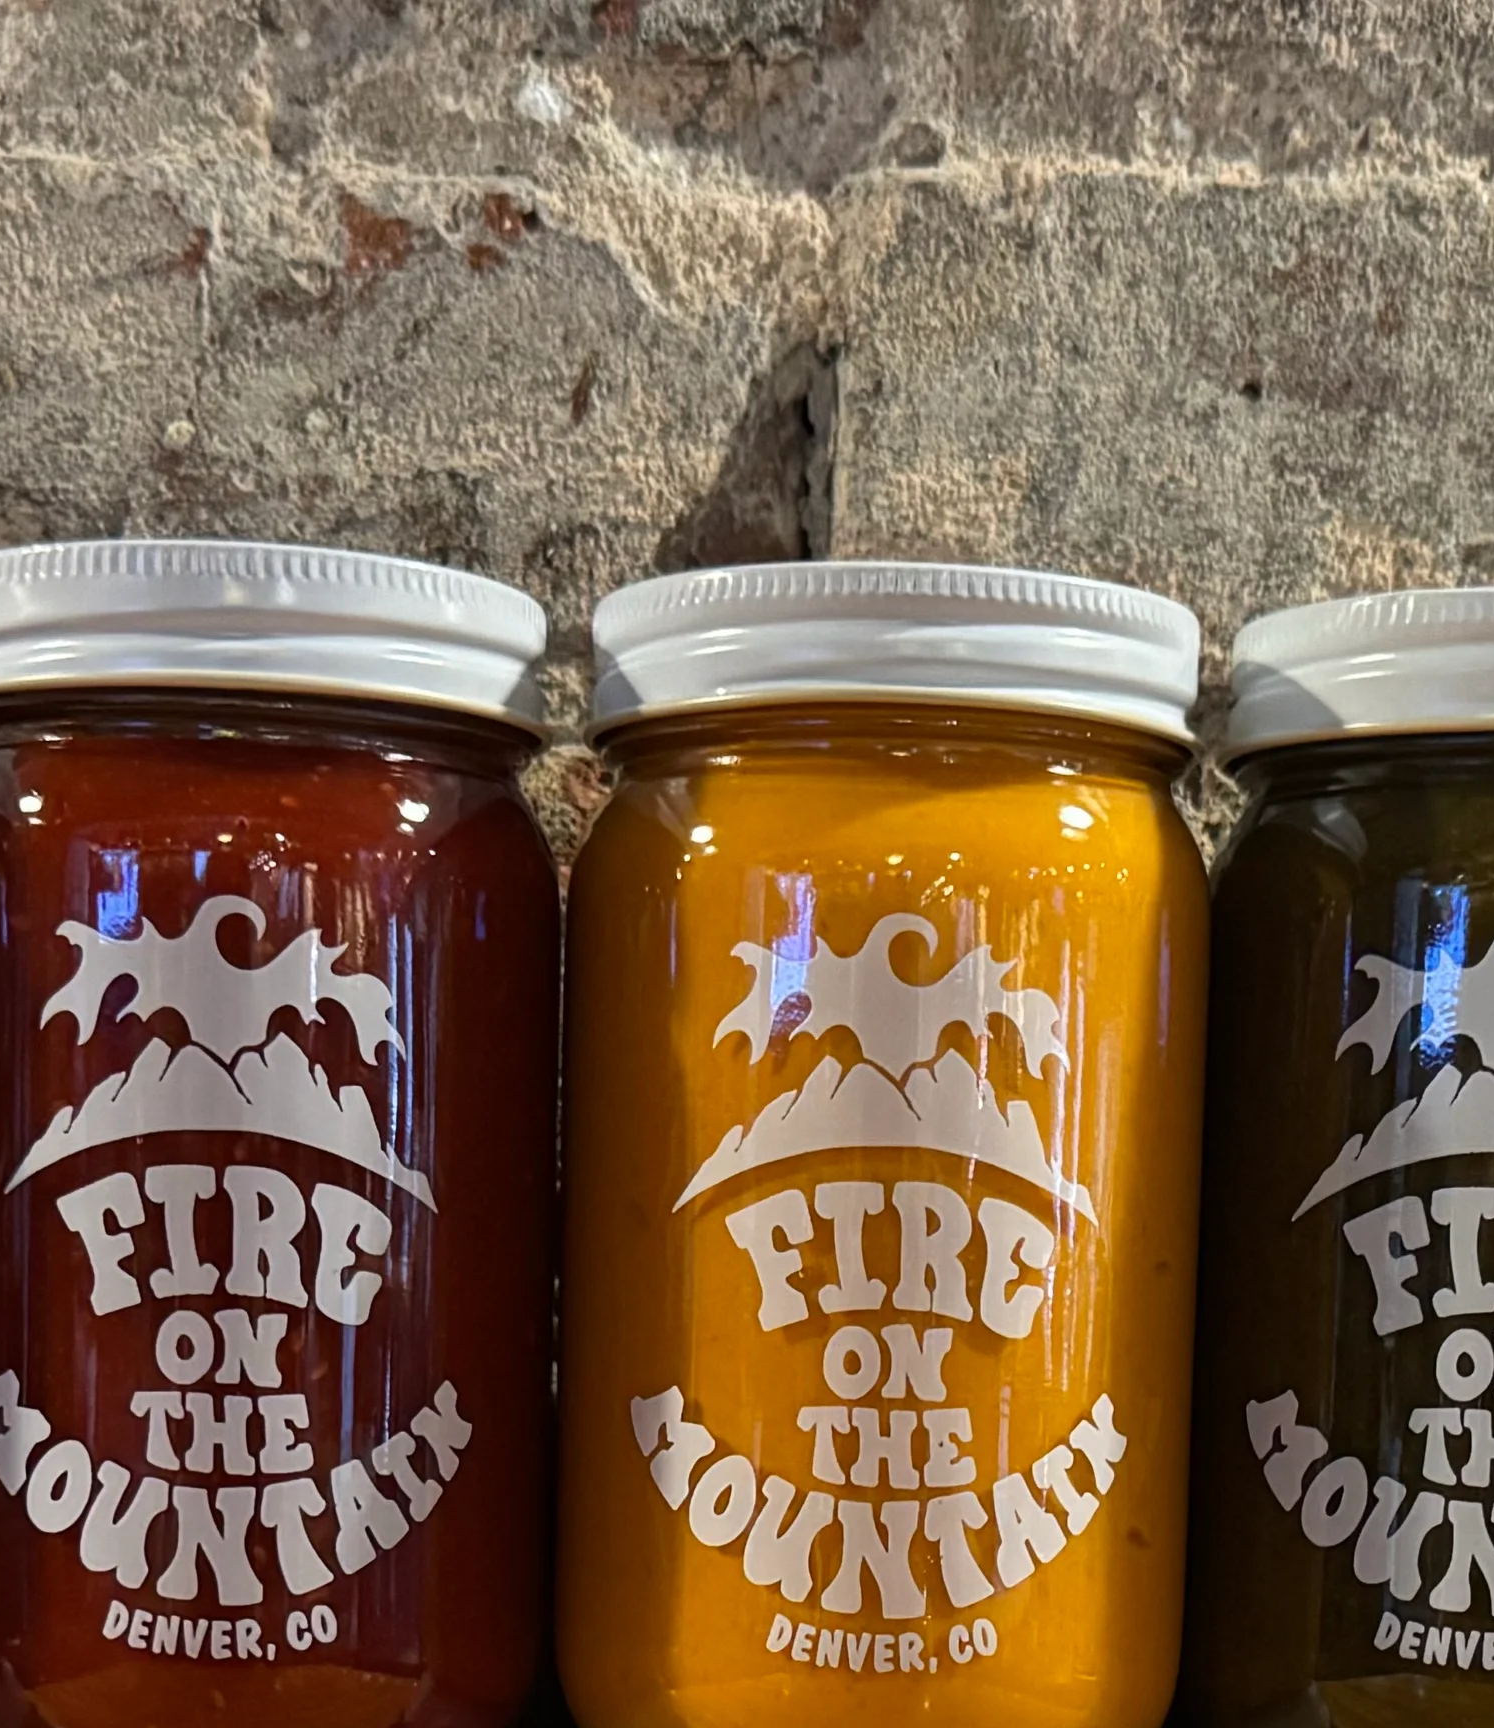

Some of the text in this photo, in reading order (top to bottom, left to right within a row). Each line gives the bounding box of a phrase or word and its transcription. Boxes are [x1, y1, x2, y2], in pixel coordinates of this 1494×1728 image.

[57, 1164, 392, 1326] FIRE
[726, 1181, 1055, 1339] FIRE
[156, 1309, 283, 1388] ON
[823, 1324, 952, 1403] ON
[131, 1392, 312, 1475] THE
[798, 1407, 977, 1488] THE
[630, 1386, 1129, 1619] MOUNTAIN
[103, 1601, 337, 1662] DENVER, CO
[766, 1614, 998, 1675] DENVER, CO
